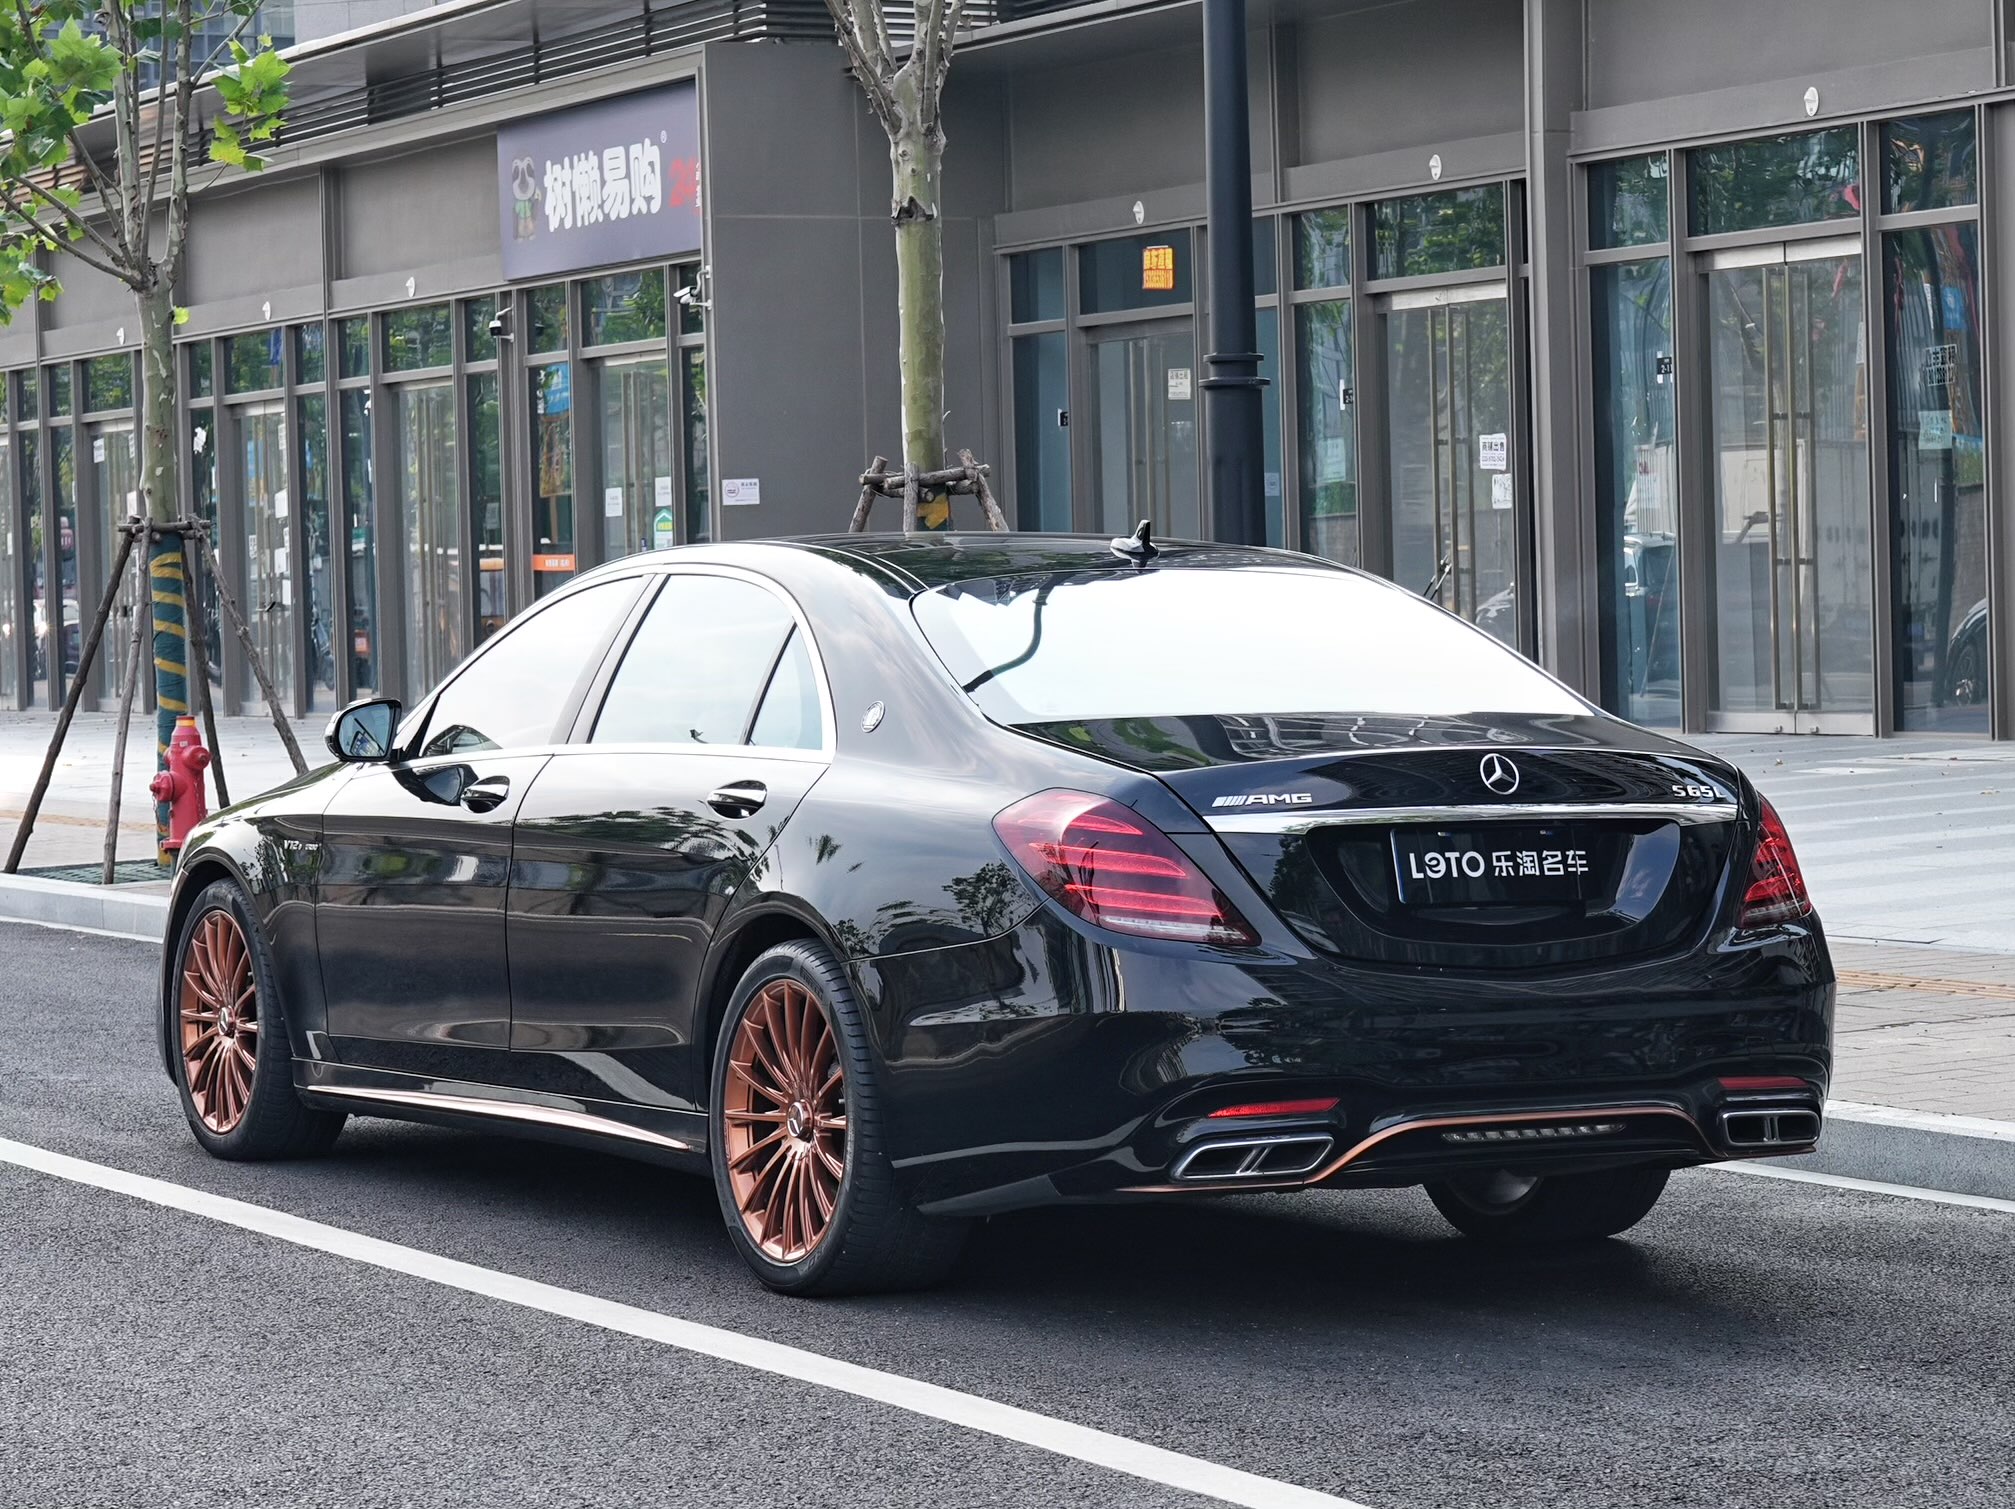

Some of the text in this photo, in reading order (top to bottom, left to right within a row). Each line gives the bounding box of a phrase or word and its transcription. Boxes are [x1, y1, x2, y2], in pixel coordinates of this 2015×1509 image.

[543, 138, 662, 232] 树懒易购
[1245, 793, 1312, 805] AMG
[1672, 785, 1727, 798] S65L
[1409, 850, 1589, 879] LOTO 乐淘名车
